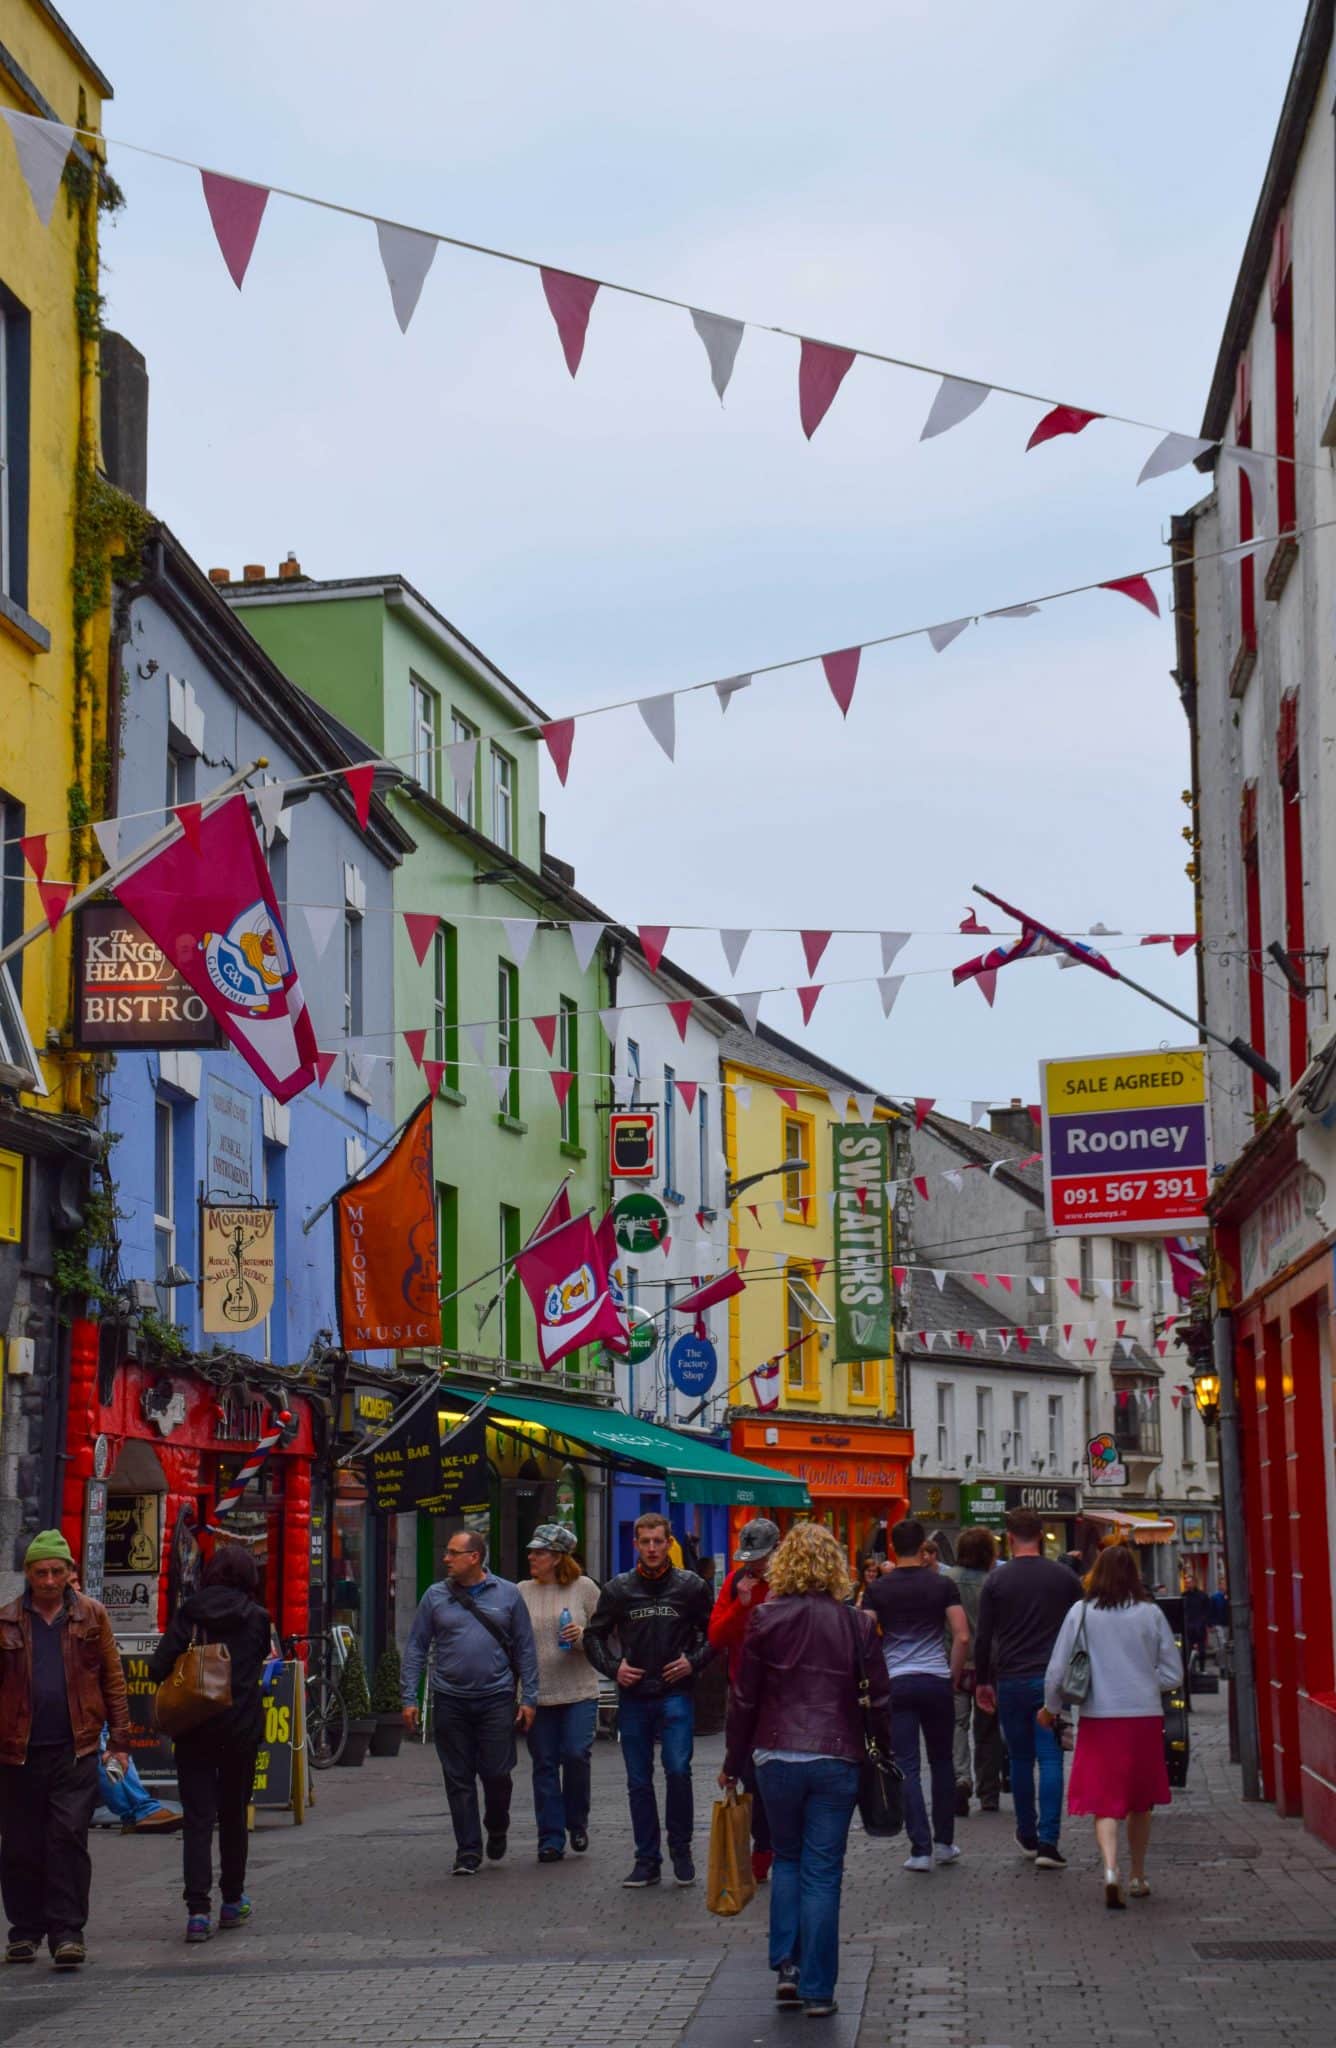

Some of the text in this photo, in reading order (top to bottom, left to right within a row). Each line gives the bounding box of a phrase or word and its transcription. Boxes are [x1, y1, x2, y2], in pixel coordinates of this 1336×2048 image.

[110, 929, 134, 943] The
[85, 962, 156, 982] HEAD
[85, 995, 208, 1023] BISTRO
[1066, 1071, 1184, 1095] SALE AGREED
[1066, 1125, 1190, 1154] Rooney
[1063, 1177, 1197, 1205] 091 567 391
[208, 1210, 273, 1238] MOLONEY
[839, 1137, 884, 1305] SWEATERS
[347, 1205, 367, 1319] MOLONEY
[356, 1324, 429, 1341] MUSIC
[686, 1349, 702, 1358] The
[678, 1360, 709, 1370] Factory
[682, 1371, 704, 1382] Shop
[374, 1444, 430, 1464] NAIL BAR
[1020, 1487, 1059, 1509] CHOICE
